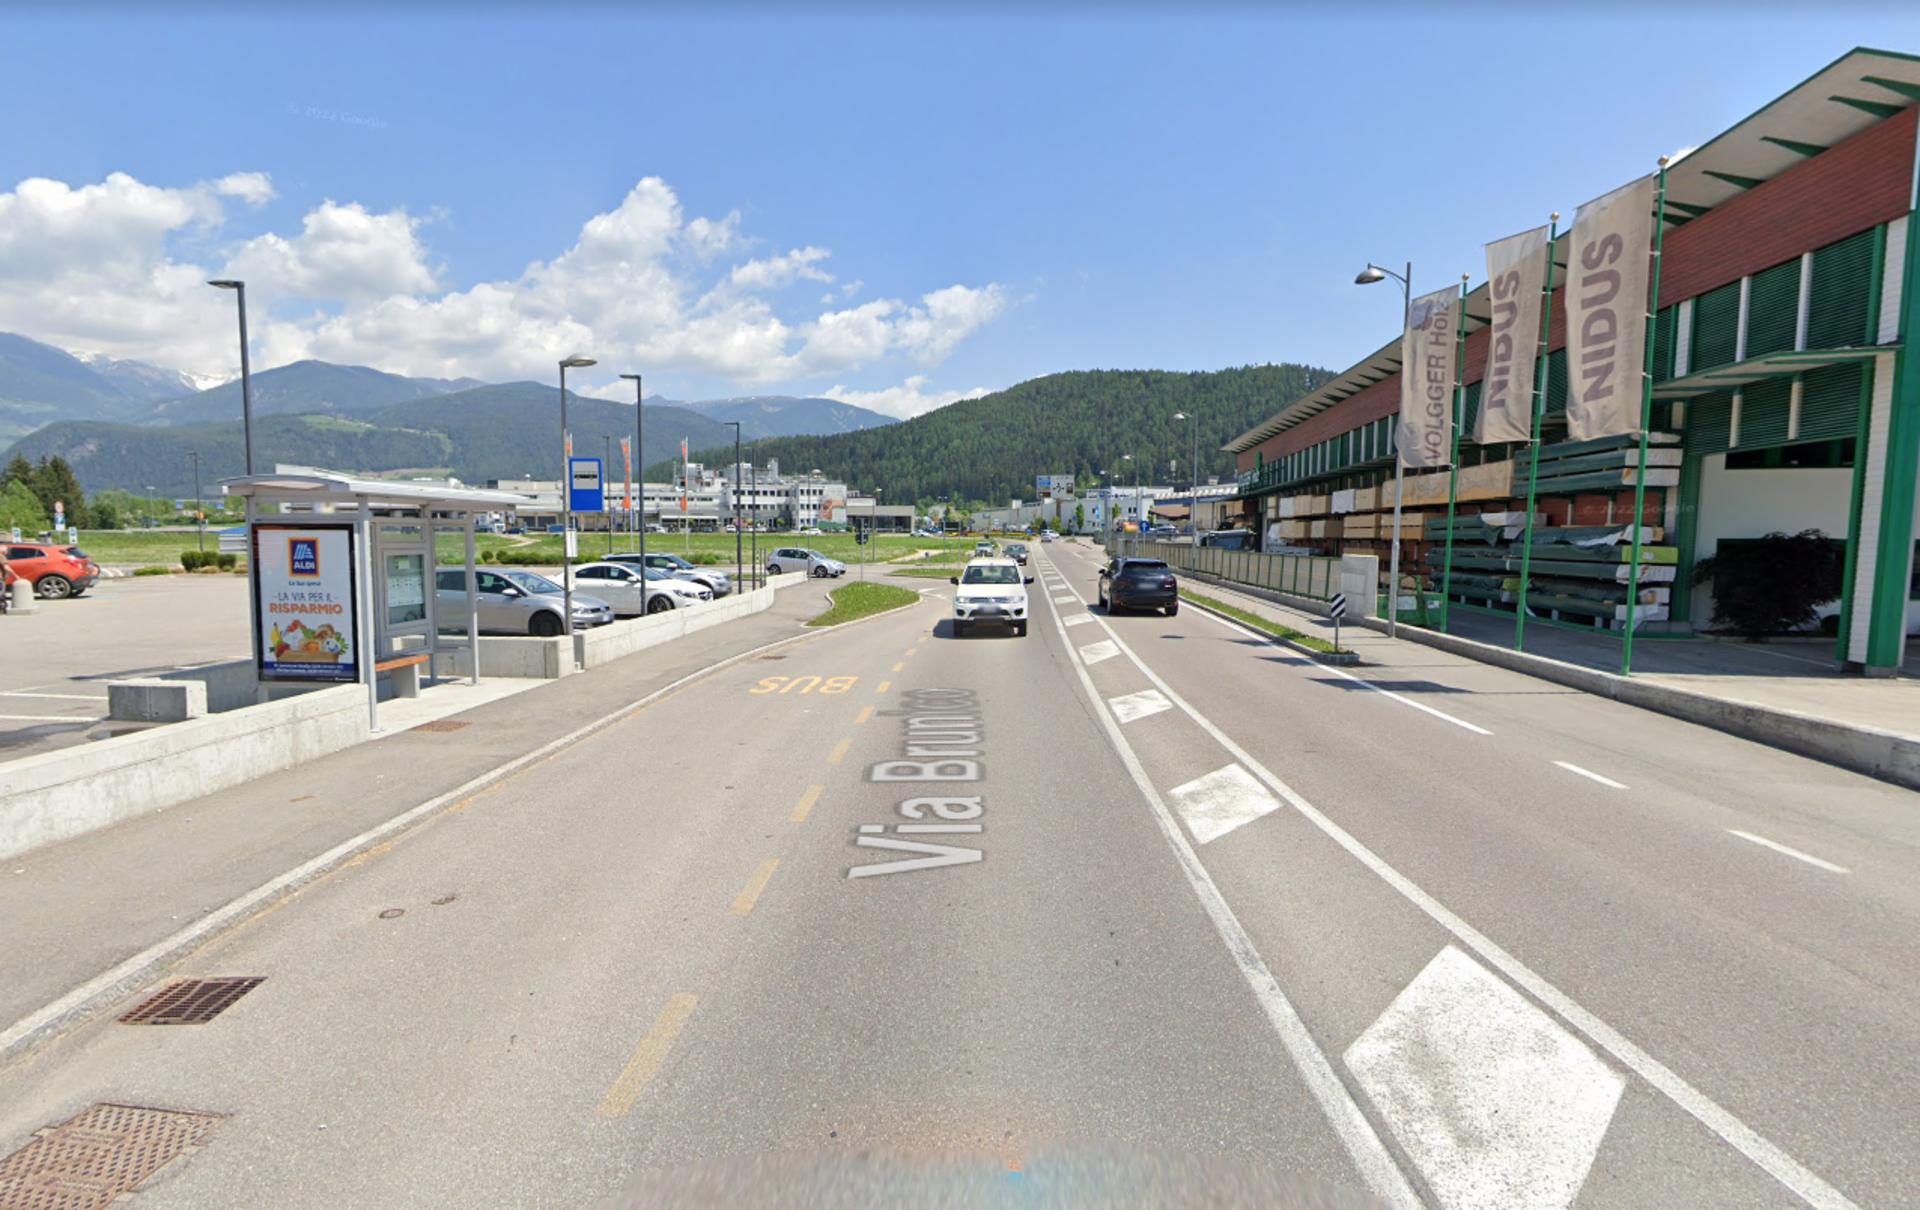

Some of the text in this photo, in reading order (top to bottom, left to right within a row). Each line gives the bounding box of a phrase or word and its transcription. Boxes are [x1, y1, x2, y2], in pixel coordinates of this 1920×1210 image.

[1581, 233, 1623, 402] NIDUS
[1487, 270, 1520, 410] NIDUS
[1424, 353, 1446, 465] VOLGGER
[294, 560, 316, 570] ALDI
[278, 592, 289, 601] LA
[291, 592, 306, 601] VIA
[308, 592, 323, 602] PER
[269, 603, 343, 614] RISPARMIO
[750, 675, 859, 695] BUS
